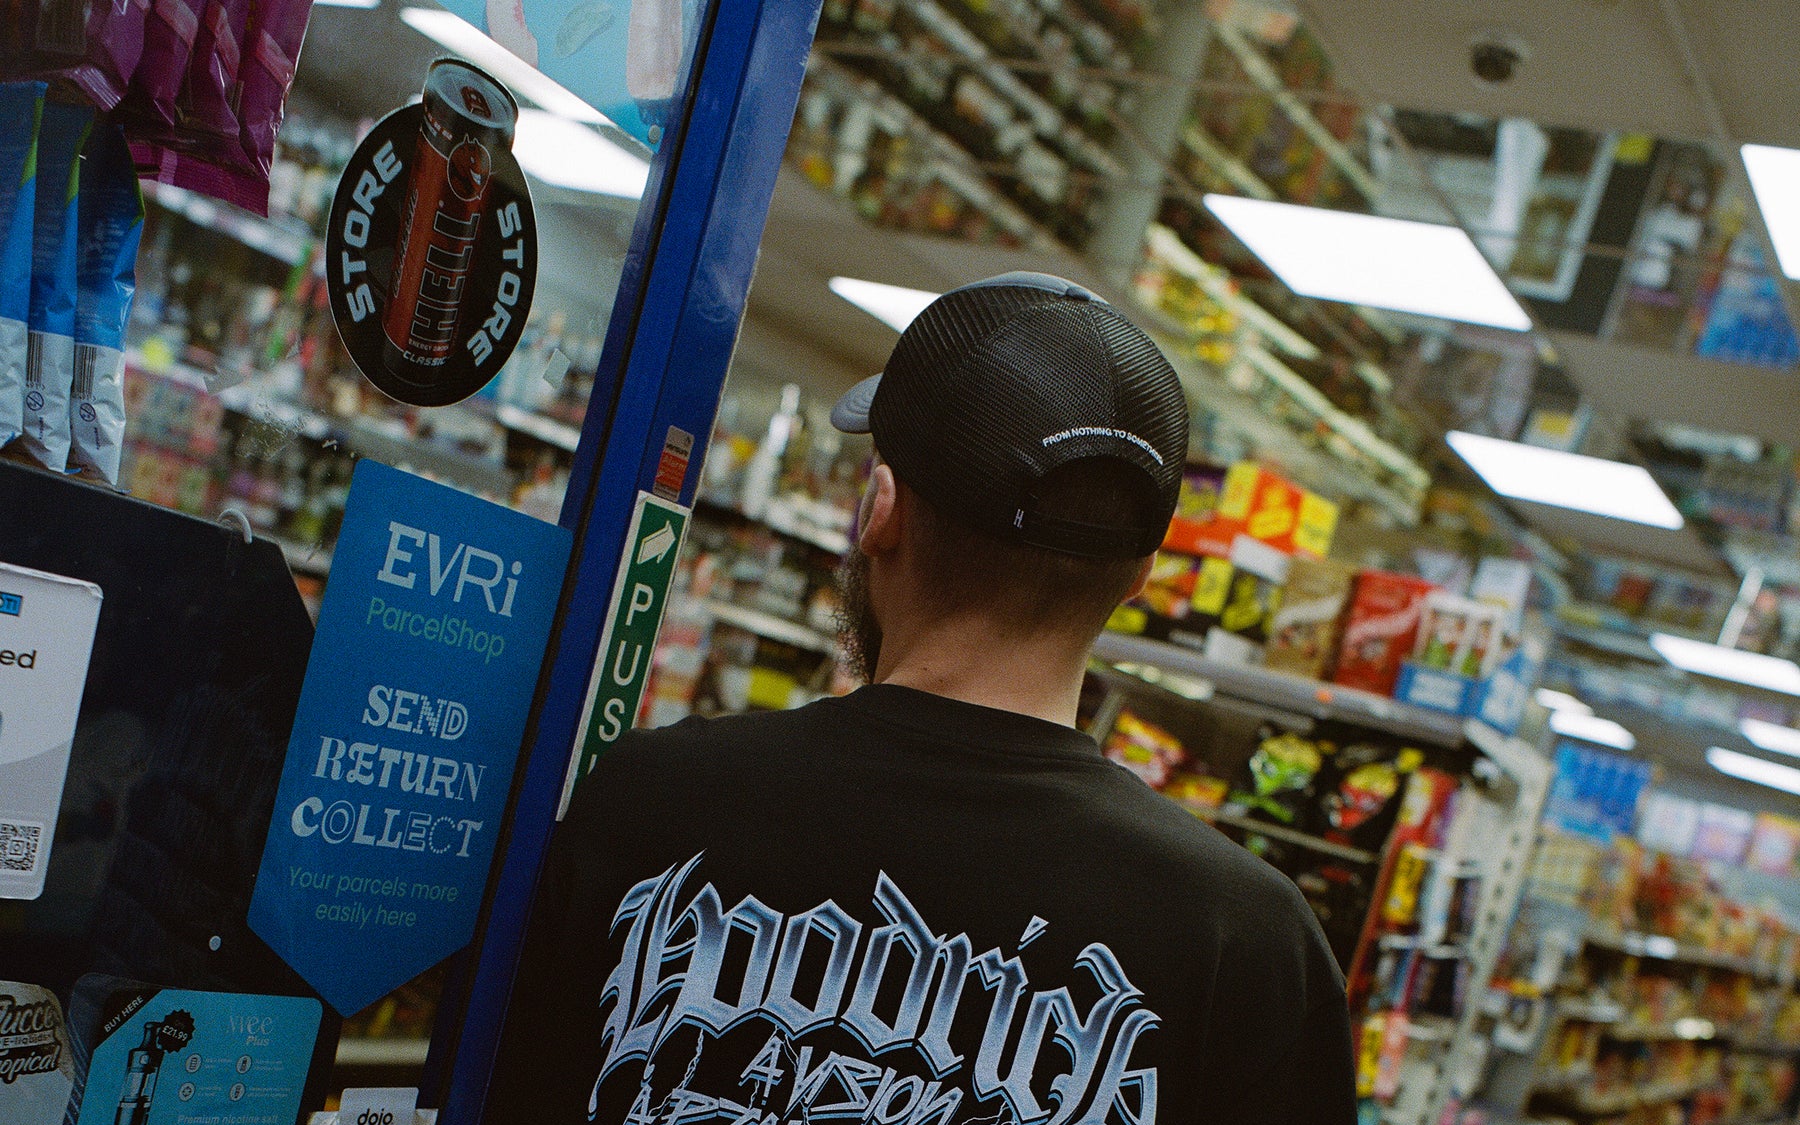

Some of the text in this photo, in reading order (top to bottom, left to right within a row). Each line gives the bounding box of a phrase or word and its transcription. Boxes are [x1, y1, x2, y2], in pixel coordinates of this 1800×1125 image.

[342, 140, 402, 323] STORE
[410, 211, 481, 343] HELL
[467, 202, 524, 367] STORE
[402, 350, 447, 367] CLASSIC
[1042, 430, 1071, 447] FROM
[1071, 427, 1113, 438] NOTHING
[1113, 429, 1127, 439] TO
[366, 596, 505, 665] ParcelShop
[587, 582, 654, 775] PUS
[361, 684, 468, 741] SEND
[311, 735, 488, 802] RETURN
[290, 796, 484, 857] COLLECT
[289, 866, 459, 902] Your parcels more
[315, 901, 417, 929] easily here
[103, 995, 144, 1034] BUY HERE
[0, 1045, 60, 1081] opical
[738, 1036, 785, 1105] A
